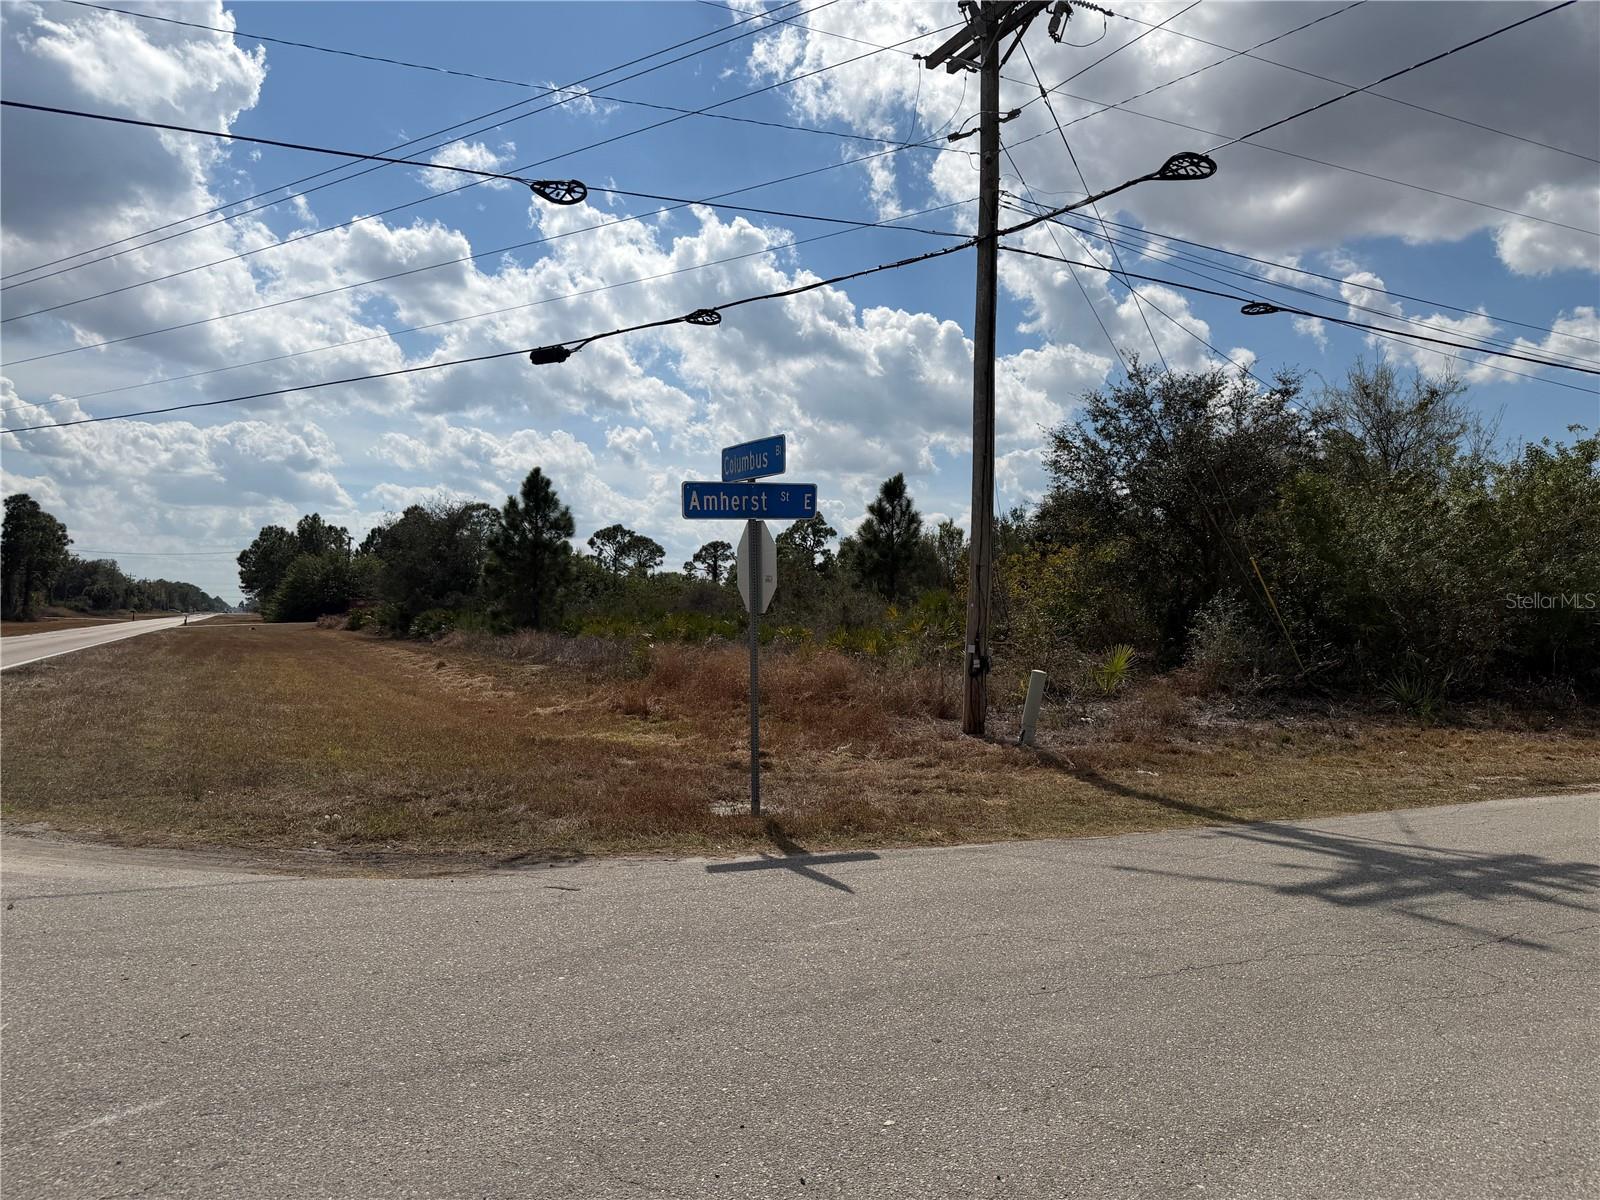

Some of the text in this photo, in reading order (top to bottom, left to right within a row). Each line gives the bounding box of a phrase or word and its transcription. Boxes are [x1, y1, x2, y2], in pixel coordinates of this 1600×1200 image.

[724, 451, 768, 475] Columbus
[689, 490, 812, 511] Amherst St E
